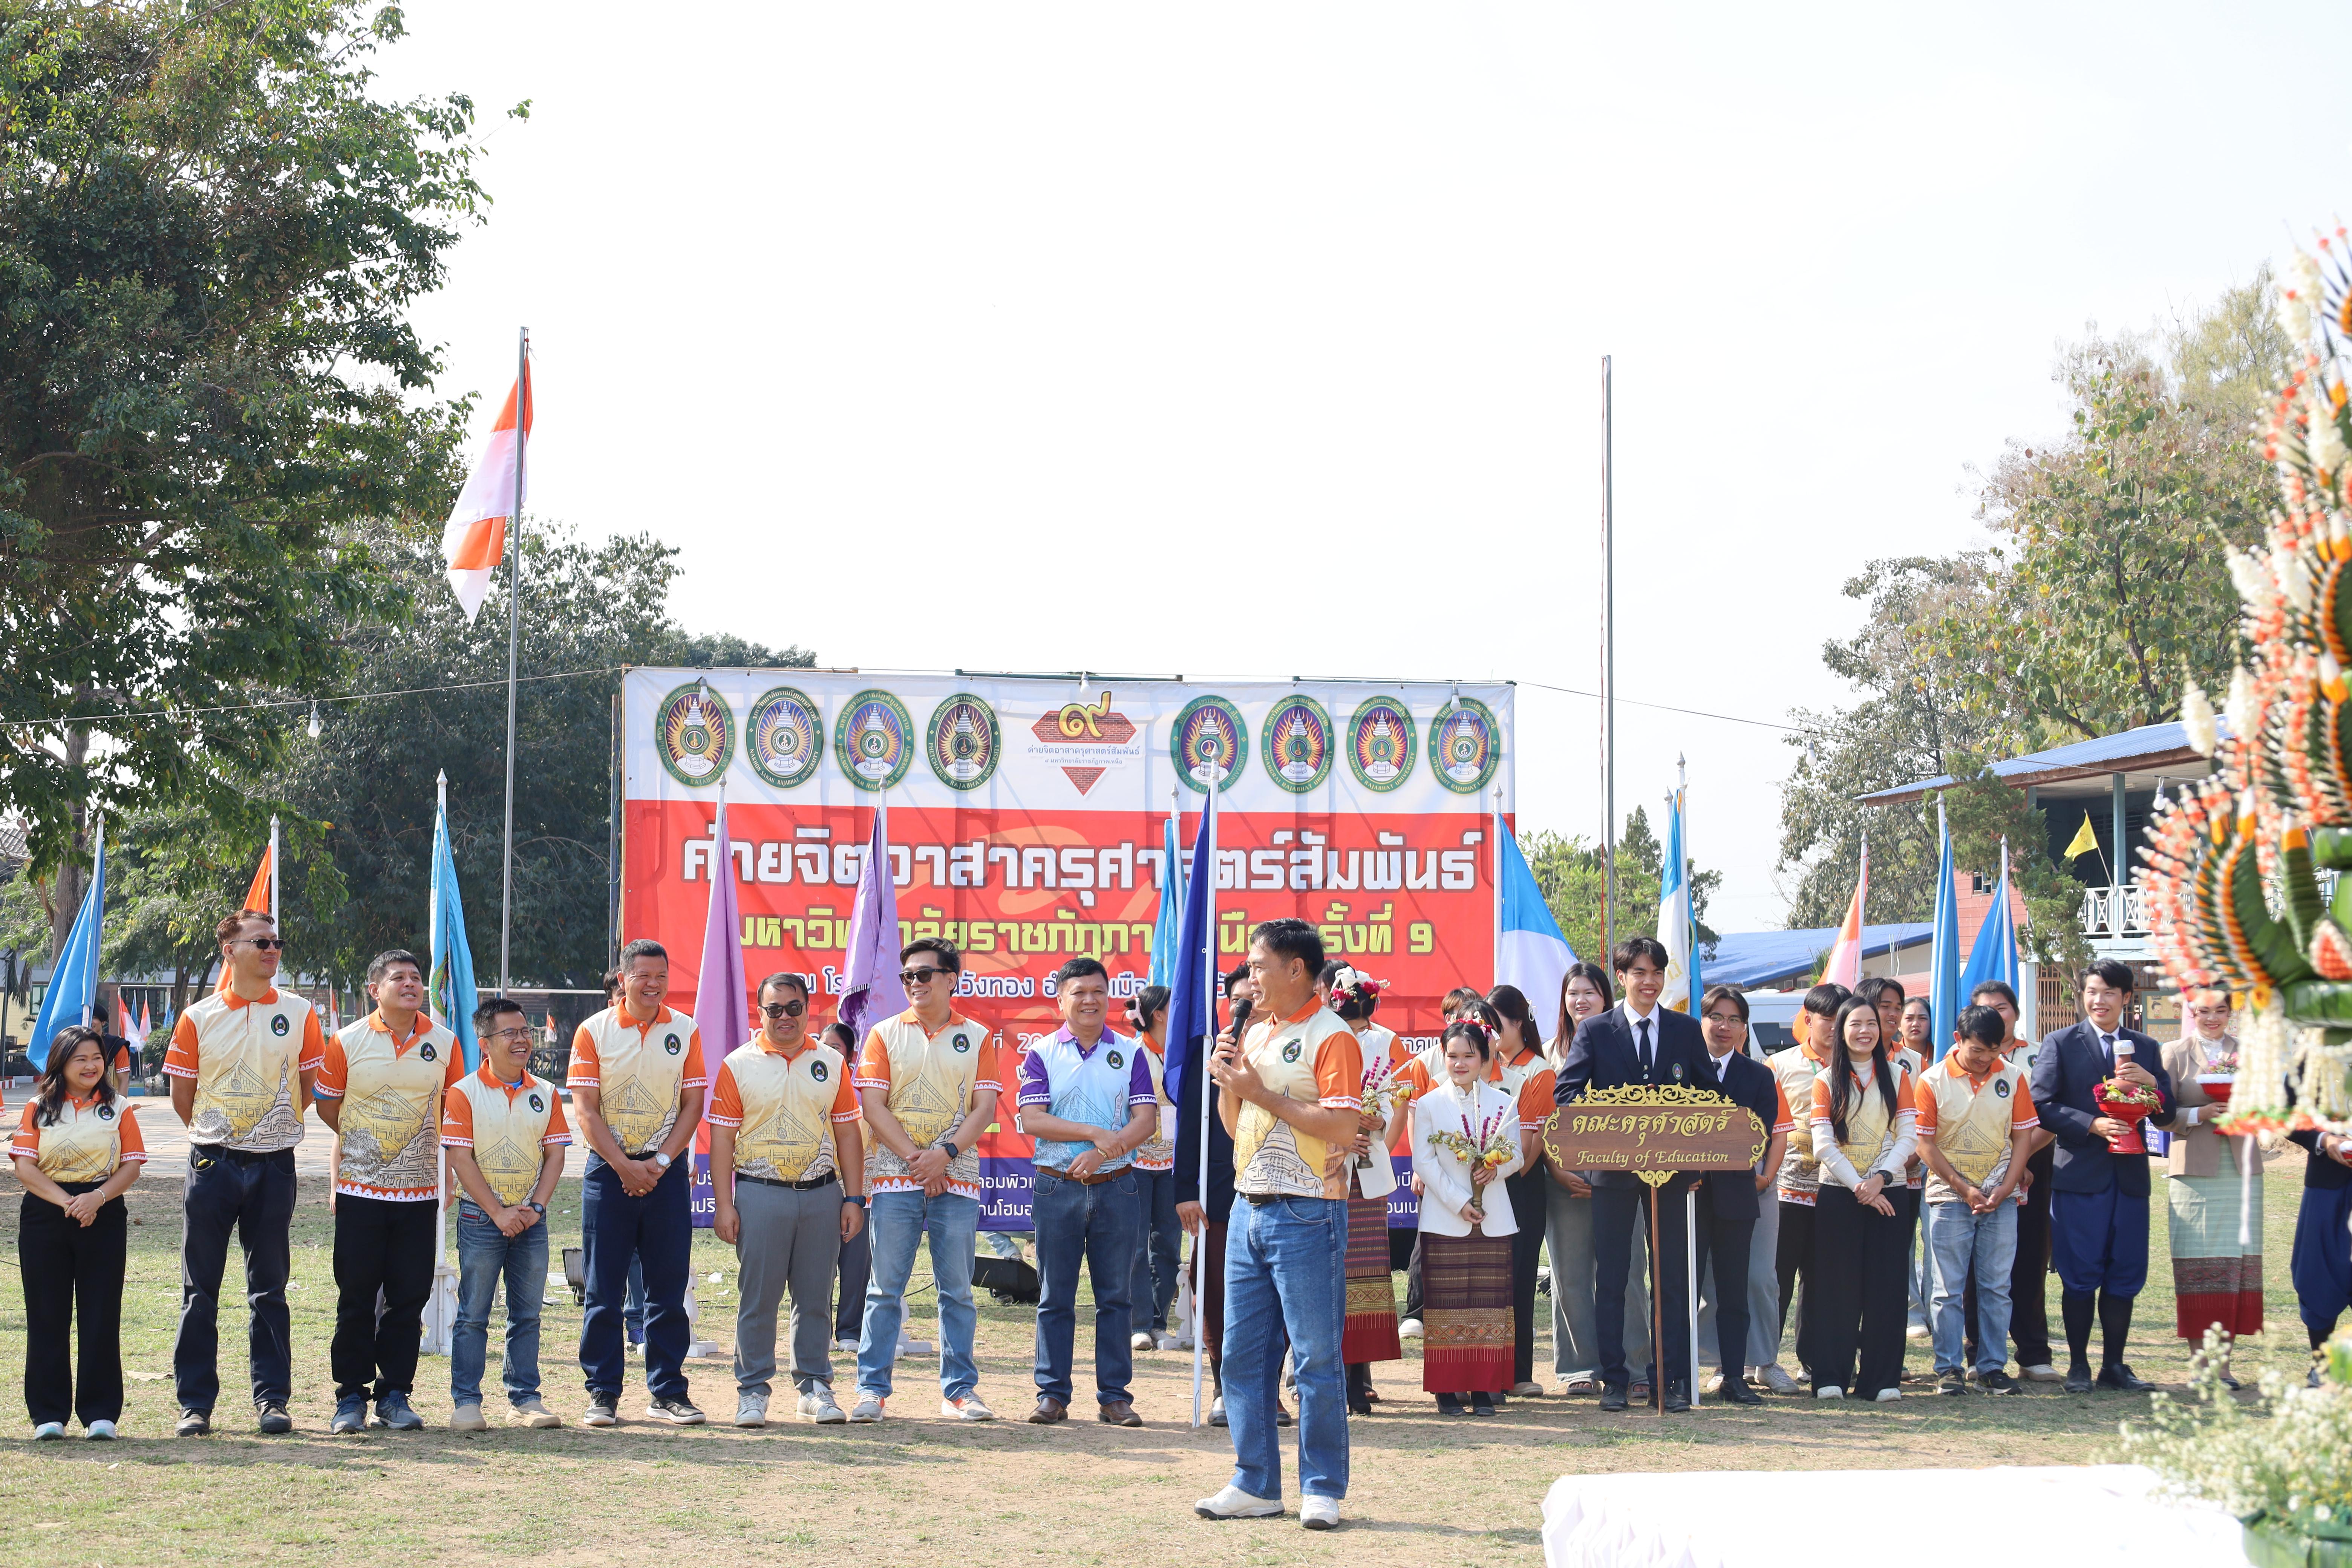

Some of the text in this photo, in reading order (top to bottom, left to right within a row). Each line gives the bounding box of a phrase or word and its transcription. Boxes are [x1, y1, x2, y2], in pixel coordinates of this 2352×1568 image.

[839, 691, 910, 730] มหาวิทยาลัยราชภัฏพิบูลสงคราม
[1266, 697, 1329, 727] มหาวิทยาลัยราชภัฏเชียงราย
[1353, 697, 1411, 724] มหาวิทยาลัยราชภัฏลำปาง
[657, 726, 733, 785] KAMPHAENG PHET RAJABHAT UNIVERSITY
[750, 749, 819, 787] NAKHON SAWAN RAJABHAT UNIVERSITY
[838, 743, 865, 786] PIBULSONGKRAM
[895, 746, 911, 778] UNIVERSITY
[928, 742, 1000, 789] PHETCHABUN RAJABHAT UNIVERSITY
[1174, 750, 1184, 773] CHIANG
[1181, 774, 1191, 784] MAI
[1227, 751, 1246, 785] UNIVERSITY
[1263, 749, 1333, 792] CHIANGRAI RAJABHAT UNIVERSITY
[1348, 751, 1415, 791] LAMPANG RAJABHAT UNIVERSITY
[1432, 756, 1496, 792] UTTARADIT RAJABHAT UNIVERSITY
[1572, 1108, 1738, 1147] คณะครุศาสตร์
[1576, 1150, 1729, 1167] Faculty of Education
